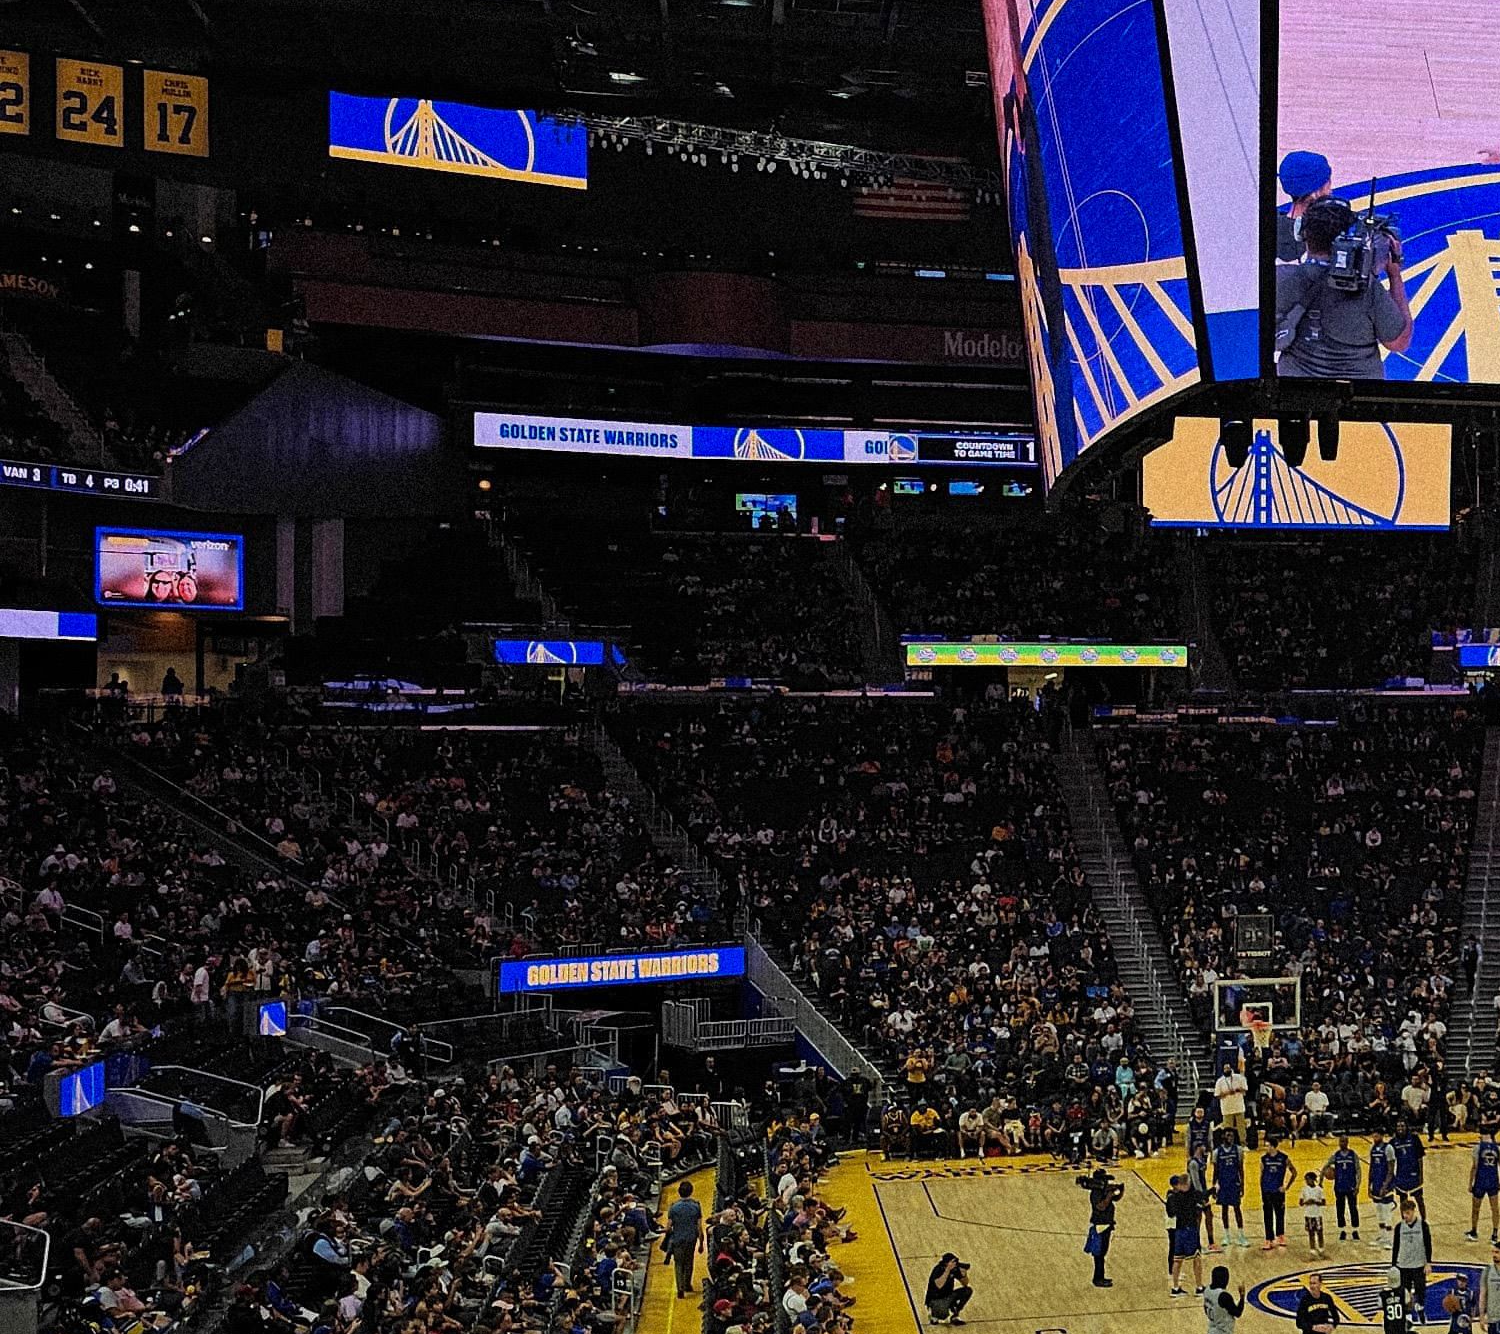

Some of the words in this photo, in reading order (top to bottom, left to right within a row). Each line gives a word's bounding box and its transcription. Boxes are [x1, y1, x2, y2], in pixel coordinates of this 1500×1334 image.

[62, 90, 117, 136] 24
[157, 102, 197, 145] 17
[944, 331, 1023, 359] Modelo
[500, 423, 556, 441] GOLDEN
[559, 427, 600, 443] STATE
[604, 430, 678, 449] WARRIORS
[956, 441, 1014, 451] COUNTDOWN
[954, 449, 966, 458] TO
[3, 465, 27, 479] VAN
[33, 468, 41, 482] 3
[61, 472, 77, 485] TB
[85, 474, 94, 488] 4
[104, 479, 119, 489] P3
[124, 479, 149, 493] 0:41
[189, 539, 229, 552] verizon
[527, 962, 588, 986] GOLDEN
[591, 959, 636, 981] STATE
[638, 953, 719, 978] WARRIORS
[1386, 1303, 1402, 1321] 30
